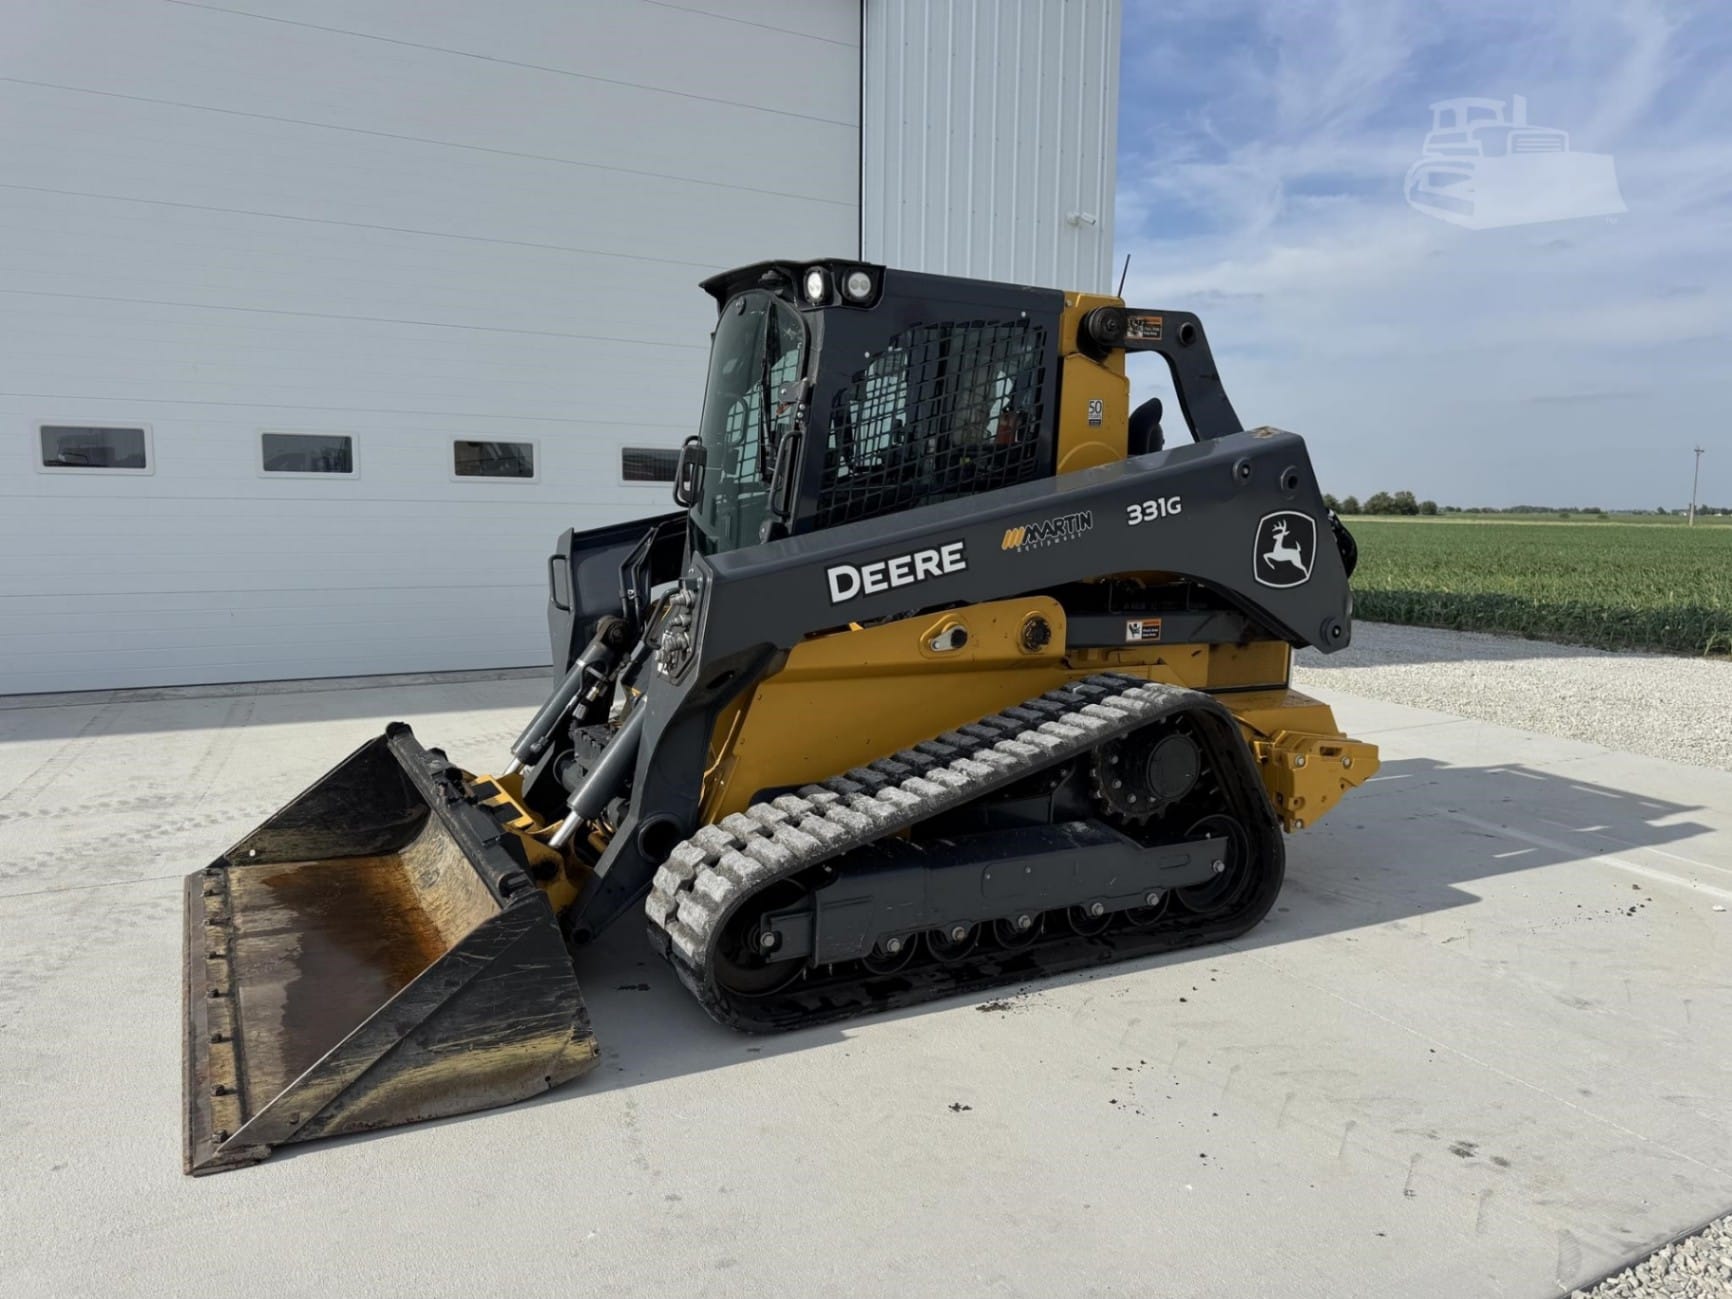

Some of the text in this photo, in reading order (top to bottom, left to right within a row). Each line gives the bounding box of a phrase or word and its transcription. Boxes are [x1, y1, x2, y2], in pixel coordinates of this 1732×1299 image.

[1089, 400, 1102, 414] 50
[1126, 496, 1182, 526] 331G
[1022, 510, 1094, 545] MARTIN
[827, 541, 967, 603] DEERE
